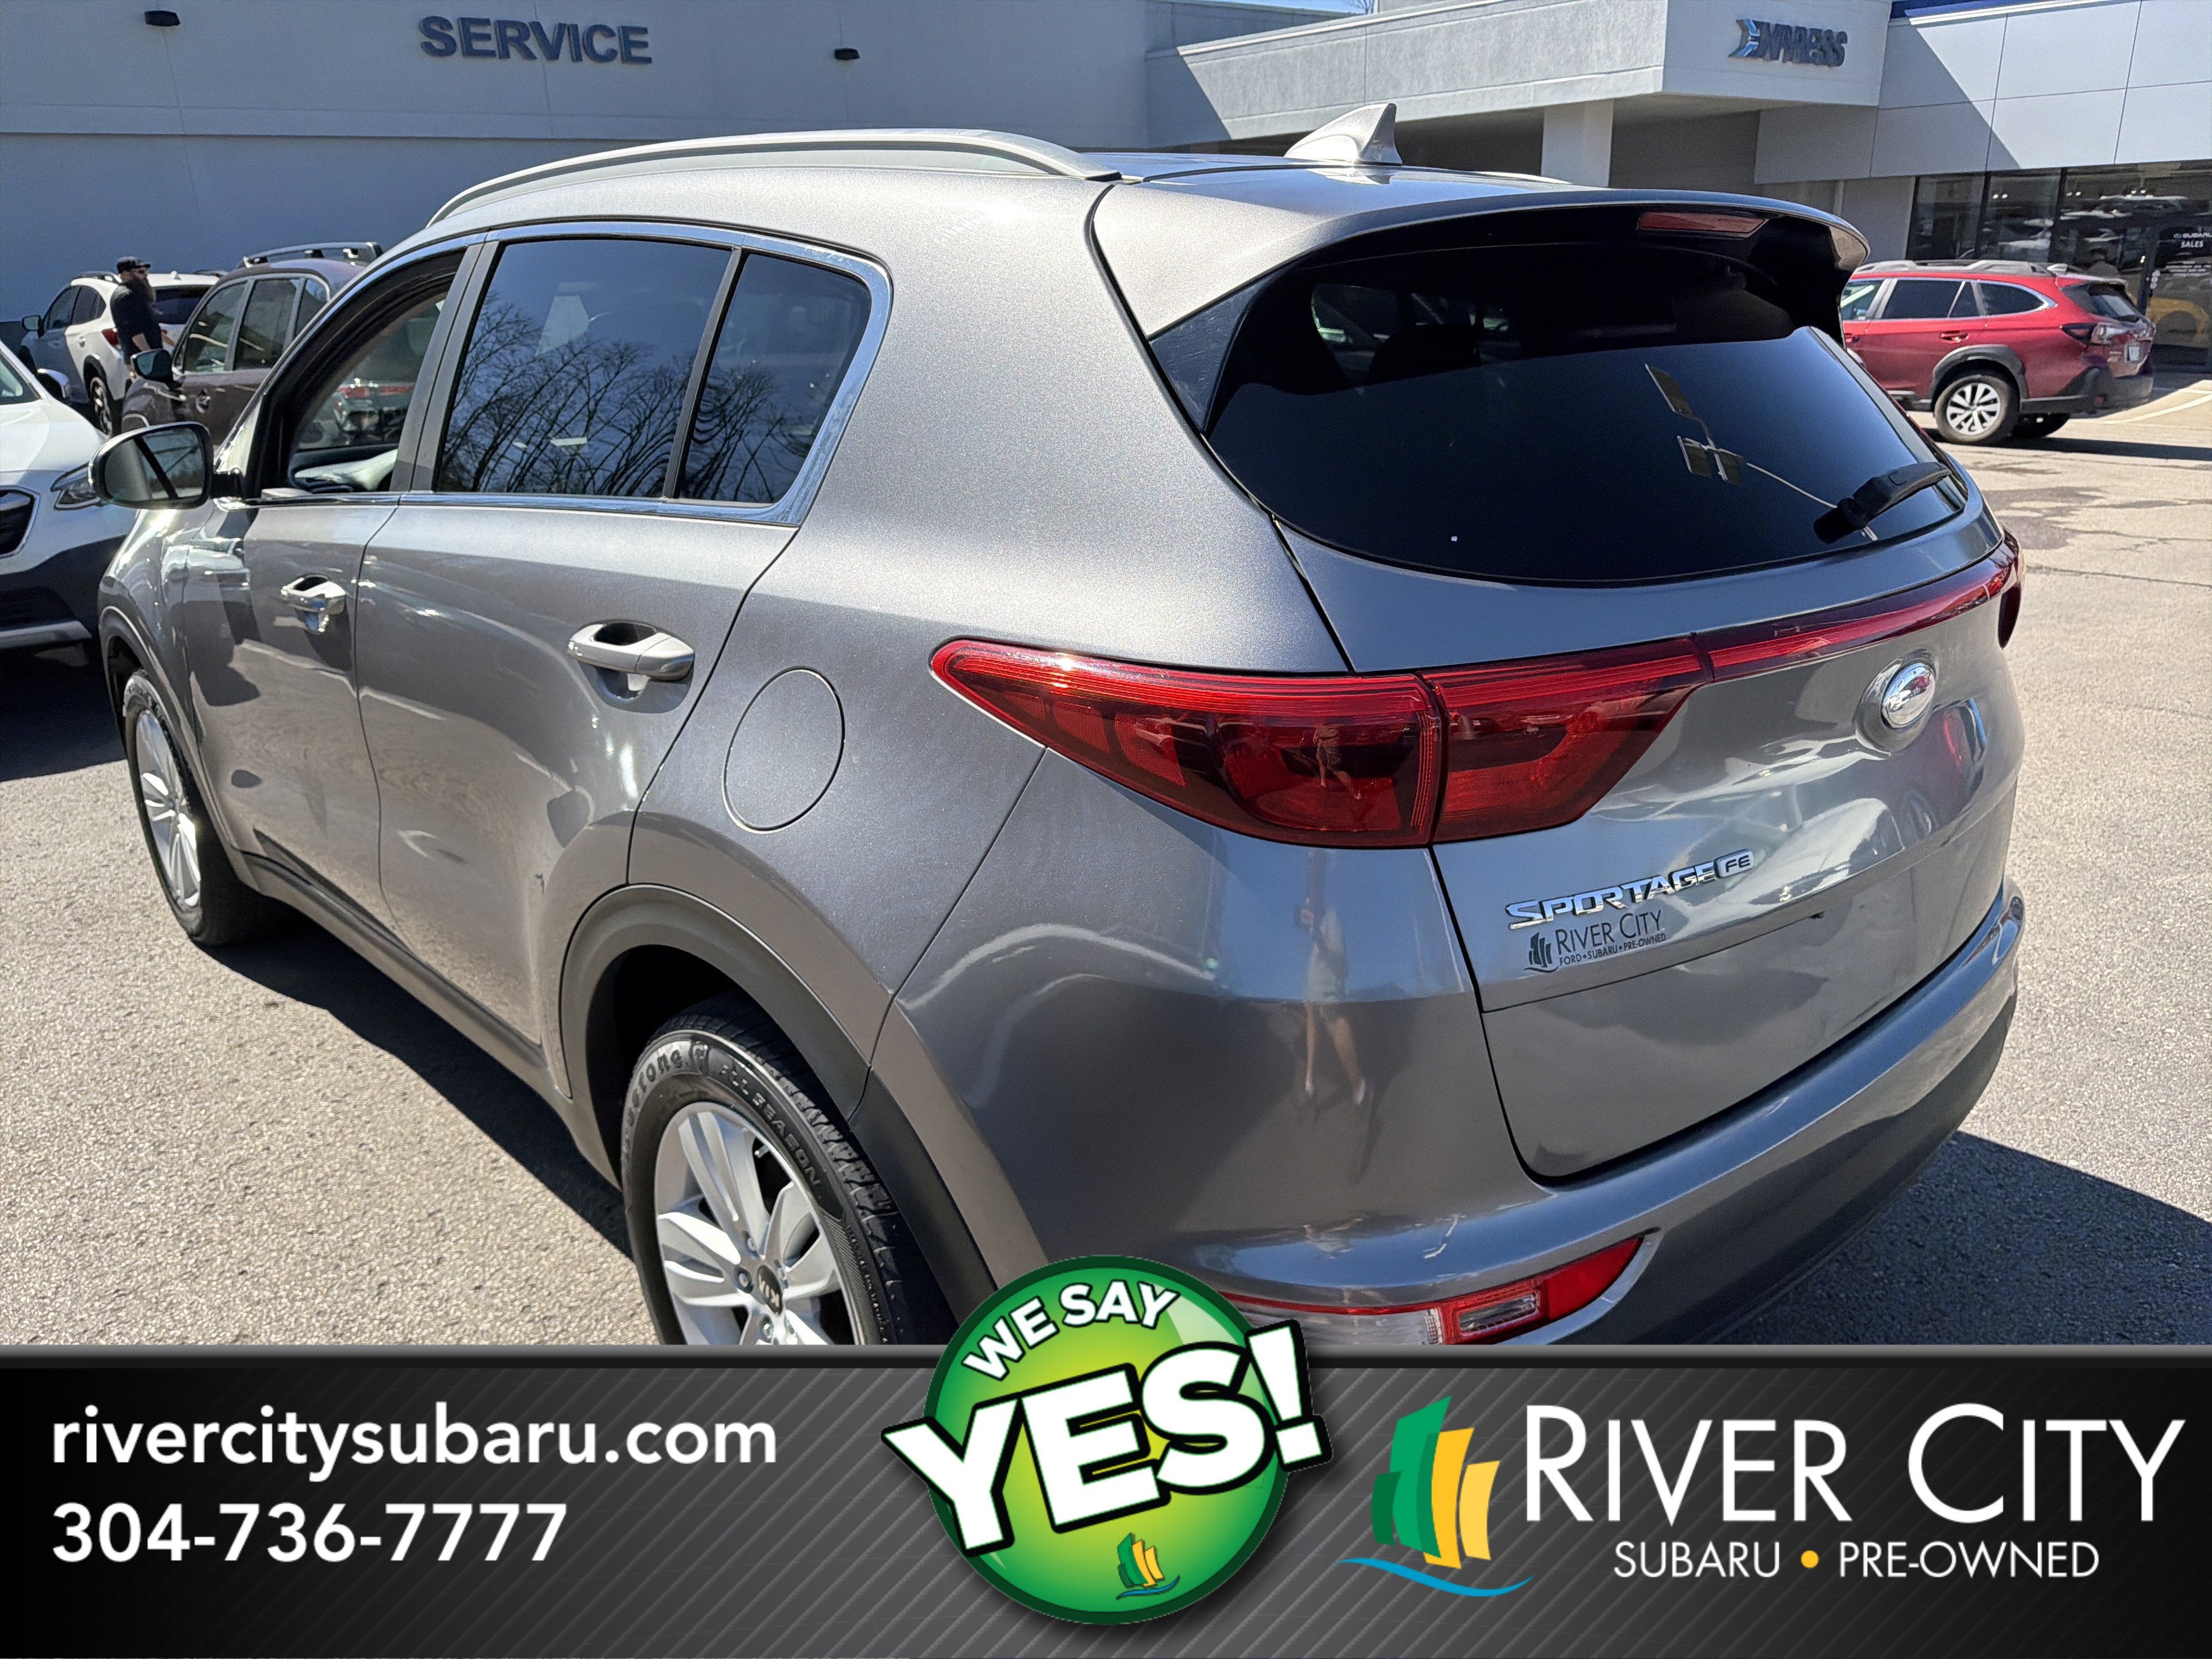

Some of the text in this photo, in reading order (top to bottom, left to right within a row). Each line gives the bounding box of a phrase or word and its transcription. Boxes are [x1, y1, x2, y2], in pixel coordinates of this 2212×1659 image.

[419, 16, 652, 64] SERVICE
[1506, 854, 1751, 929] SPORTAGE FE
[1555, 909, 1662, 955] RIVER CITY
[1559, 933, 1667, 967] FORD SUBARU PRE-OWNED
[621, 1048, 682, 1156] estone
[752, 1092, 821, 1186] SEASON
